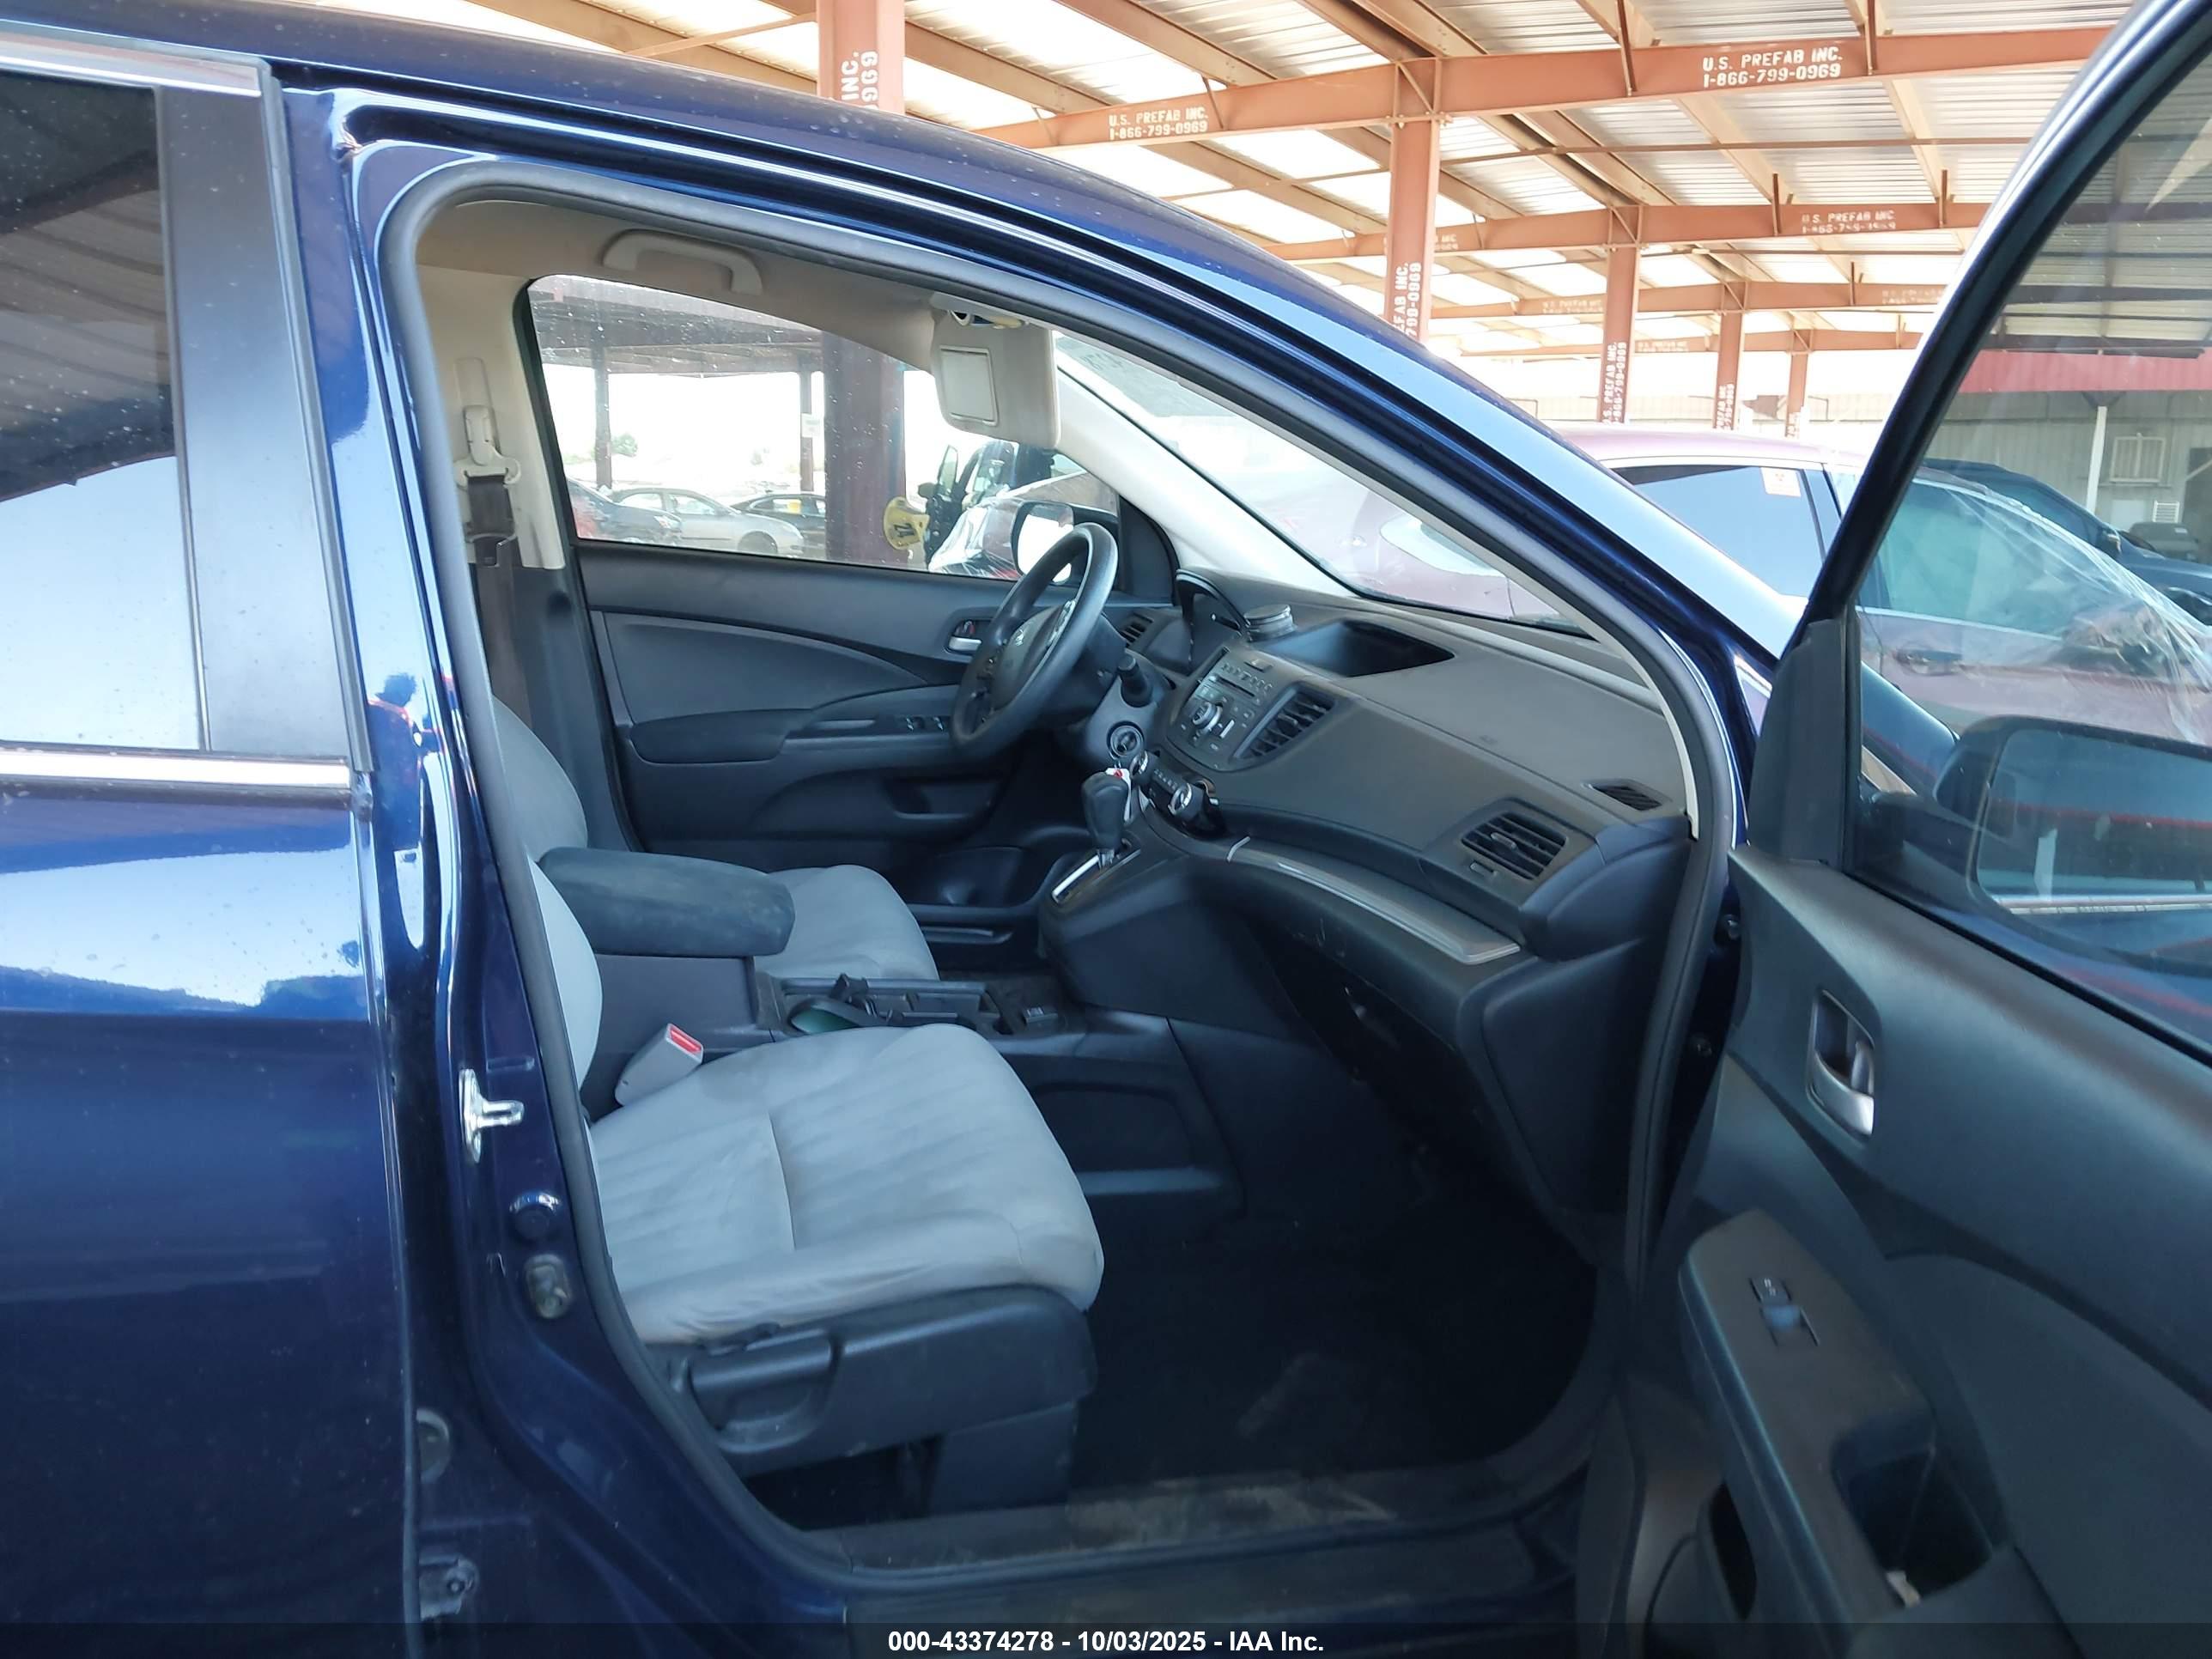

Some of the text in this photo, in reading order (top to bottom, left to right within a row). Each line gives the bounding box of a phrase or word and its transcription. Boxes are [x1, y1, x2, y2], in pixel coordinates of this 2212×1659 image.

[1702, 46, 1844, 72] U.S. PREFAB INC.
[841, 51, 860, 100] INC.
[860, 51, 878, 111] 969
[1703, 63, 1842, 88] 1-866-799-0969
[1108, 106, 1209, 127] U.S. PREFAB INC.
[1109, 120, 1208, 141] 1-866-799-0969
